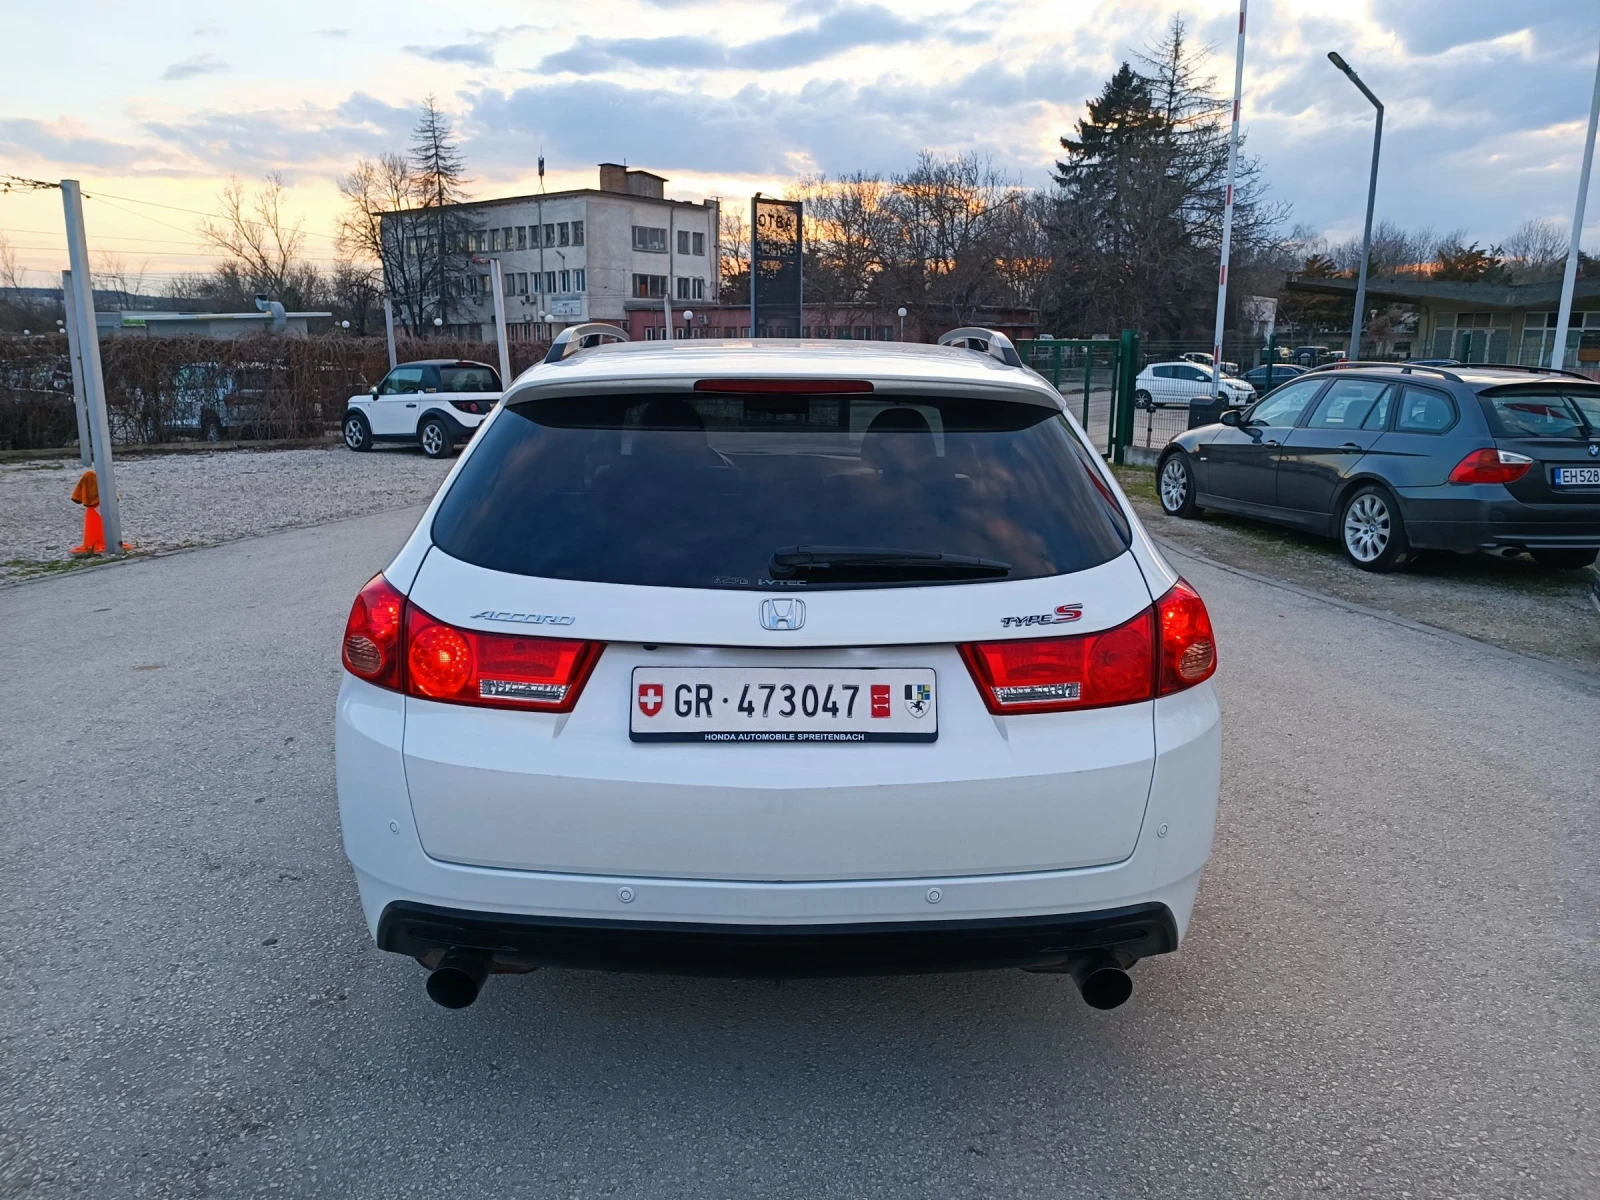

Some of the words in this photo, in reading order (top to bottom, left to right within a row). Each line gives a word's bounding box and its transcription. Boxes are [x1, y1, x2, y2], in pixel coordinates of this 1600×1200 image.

[470, 610, 575, 625] ACCORD
[704, 733, 736, 741] HONDA
[738, 733, 795, 741] AUTOMOBILE
[797, 733, 865, 741] SPREITENBACH
